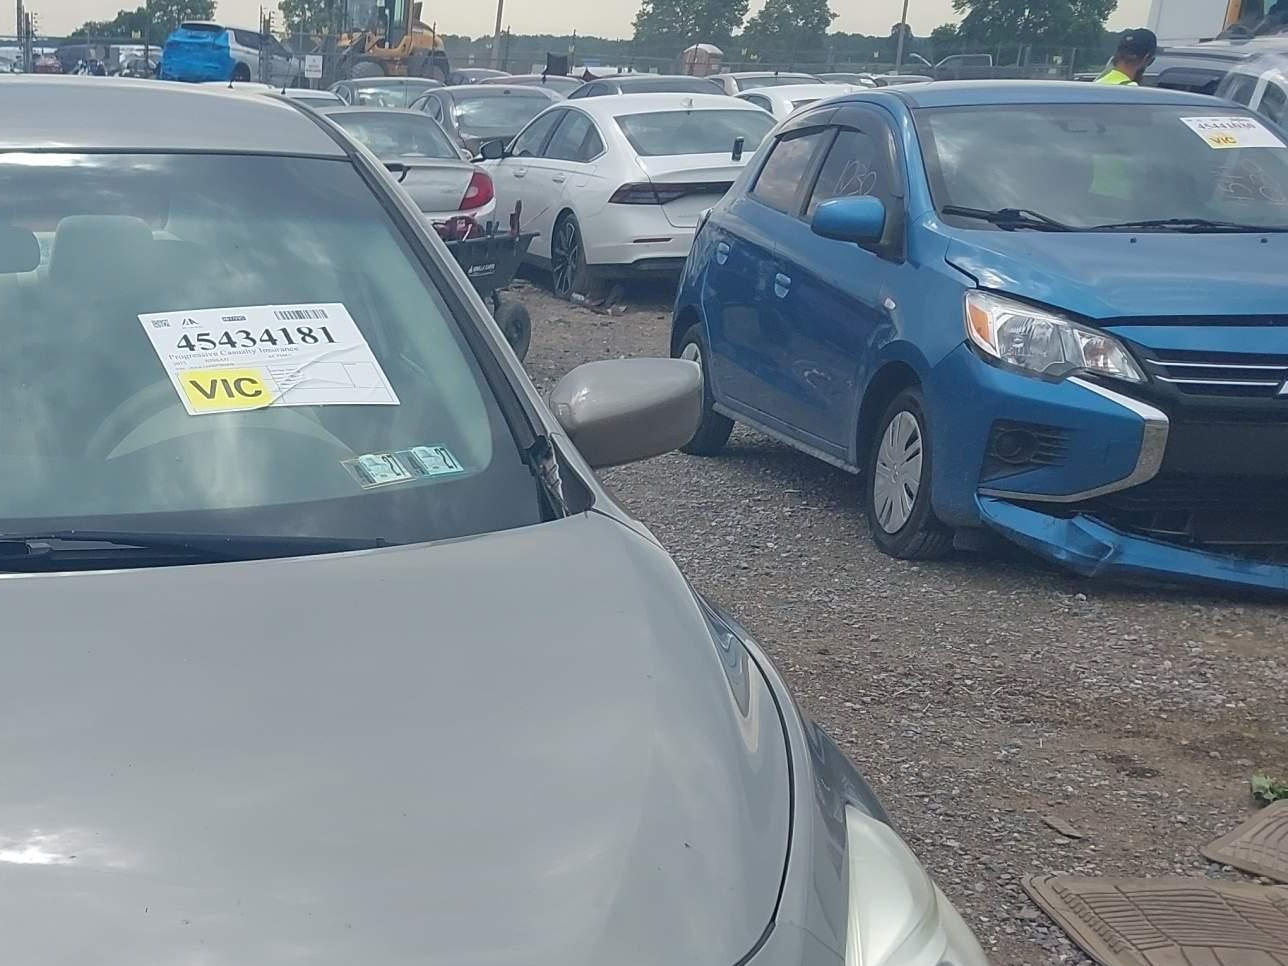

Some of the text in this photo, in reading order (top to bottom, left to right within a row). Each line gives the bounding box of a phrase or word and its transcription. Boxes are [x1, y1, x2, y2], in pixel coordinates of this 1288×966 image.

[177, 326, 338, 351] 45434181
[169, 350, 218, 361] Progressive
[189, 377, 262, 400] VIC
